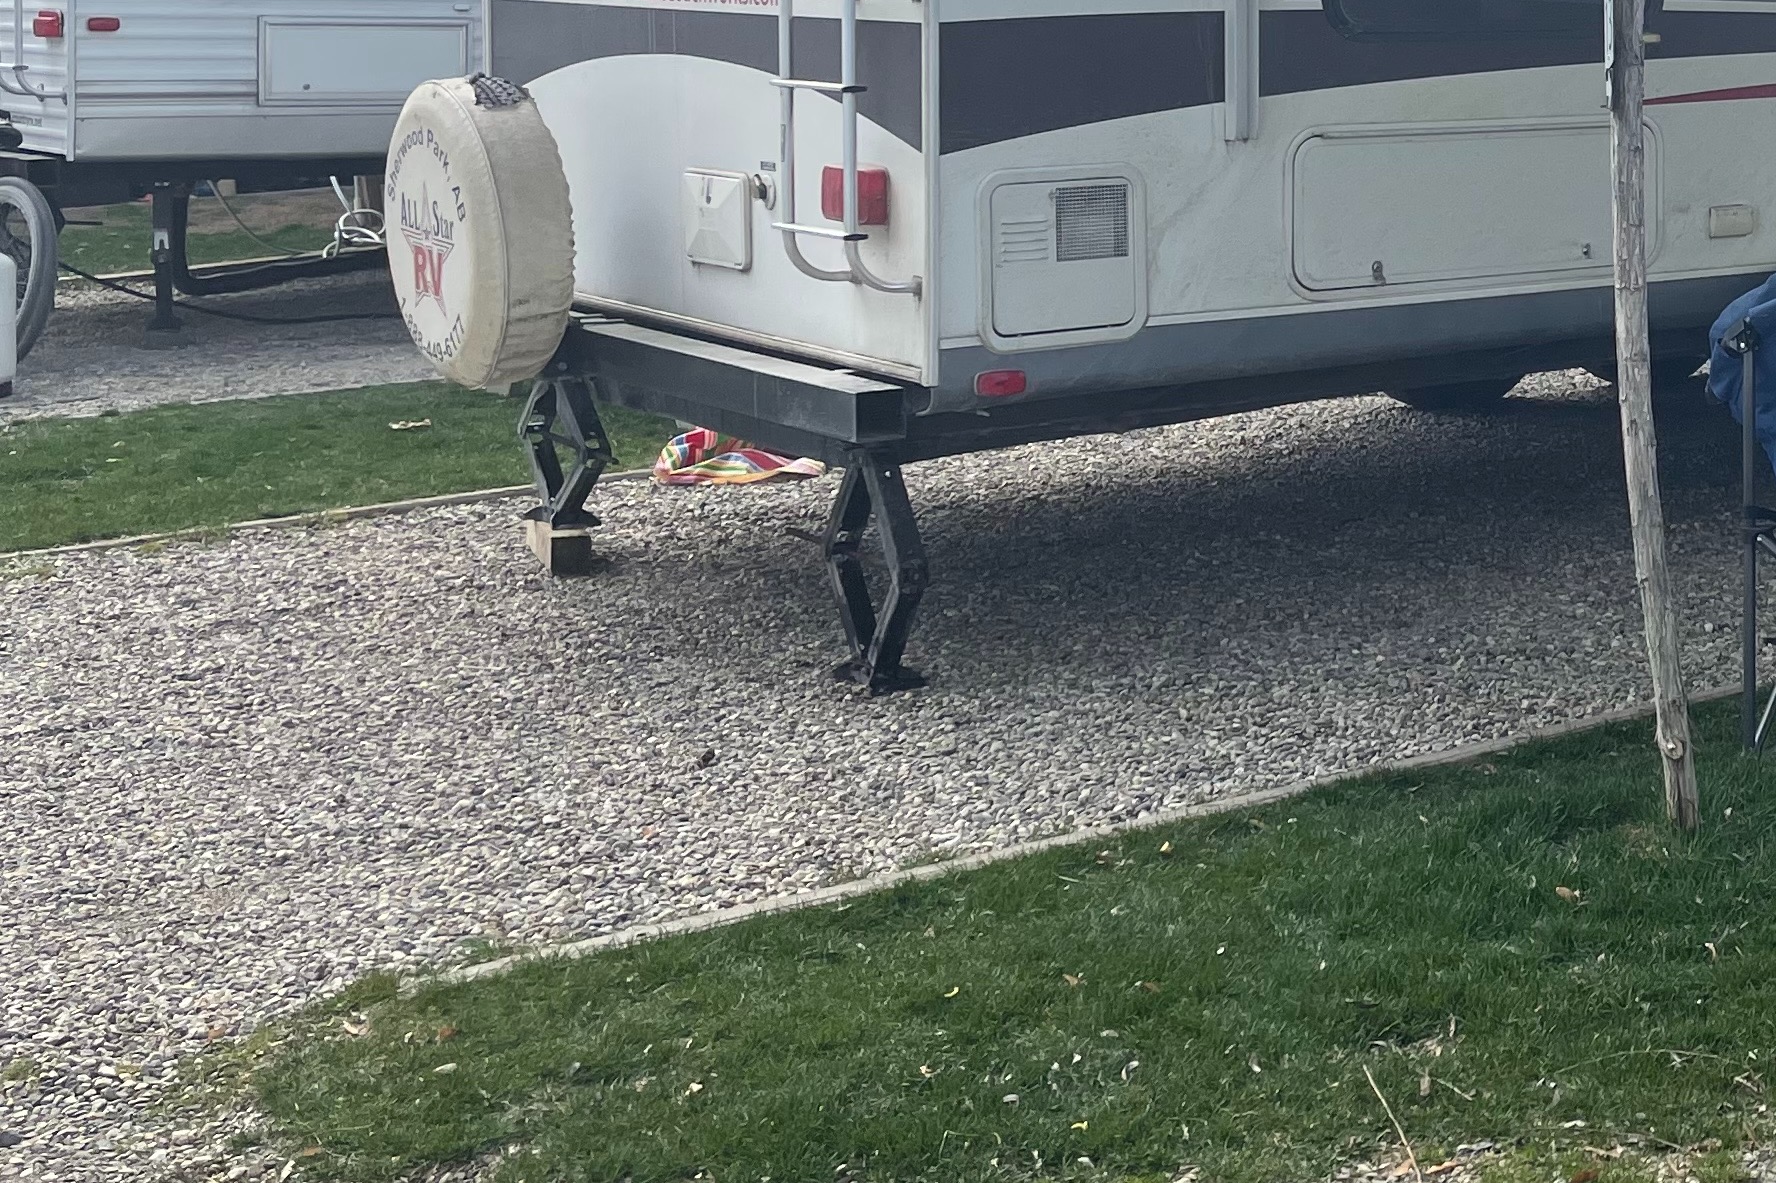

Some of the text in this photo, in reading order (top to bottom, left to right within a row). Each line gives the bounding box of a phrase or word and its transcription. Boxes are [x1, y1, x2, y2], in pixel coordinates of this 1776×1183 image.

[387, 127, 424, 202] Sherwood
[451, 185, 466, 222] AB
[401, 191, 454, 240] ALL Star
[413, 245, 443, 296] RV
[401, 297, 465, 363] 1-888-449-6177
